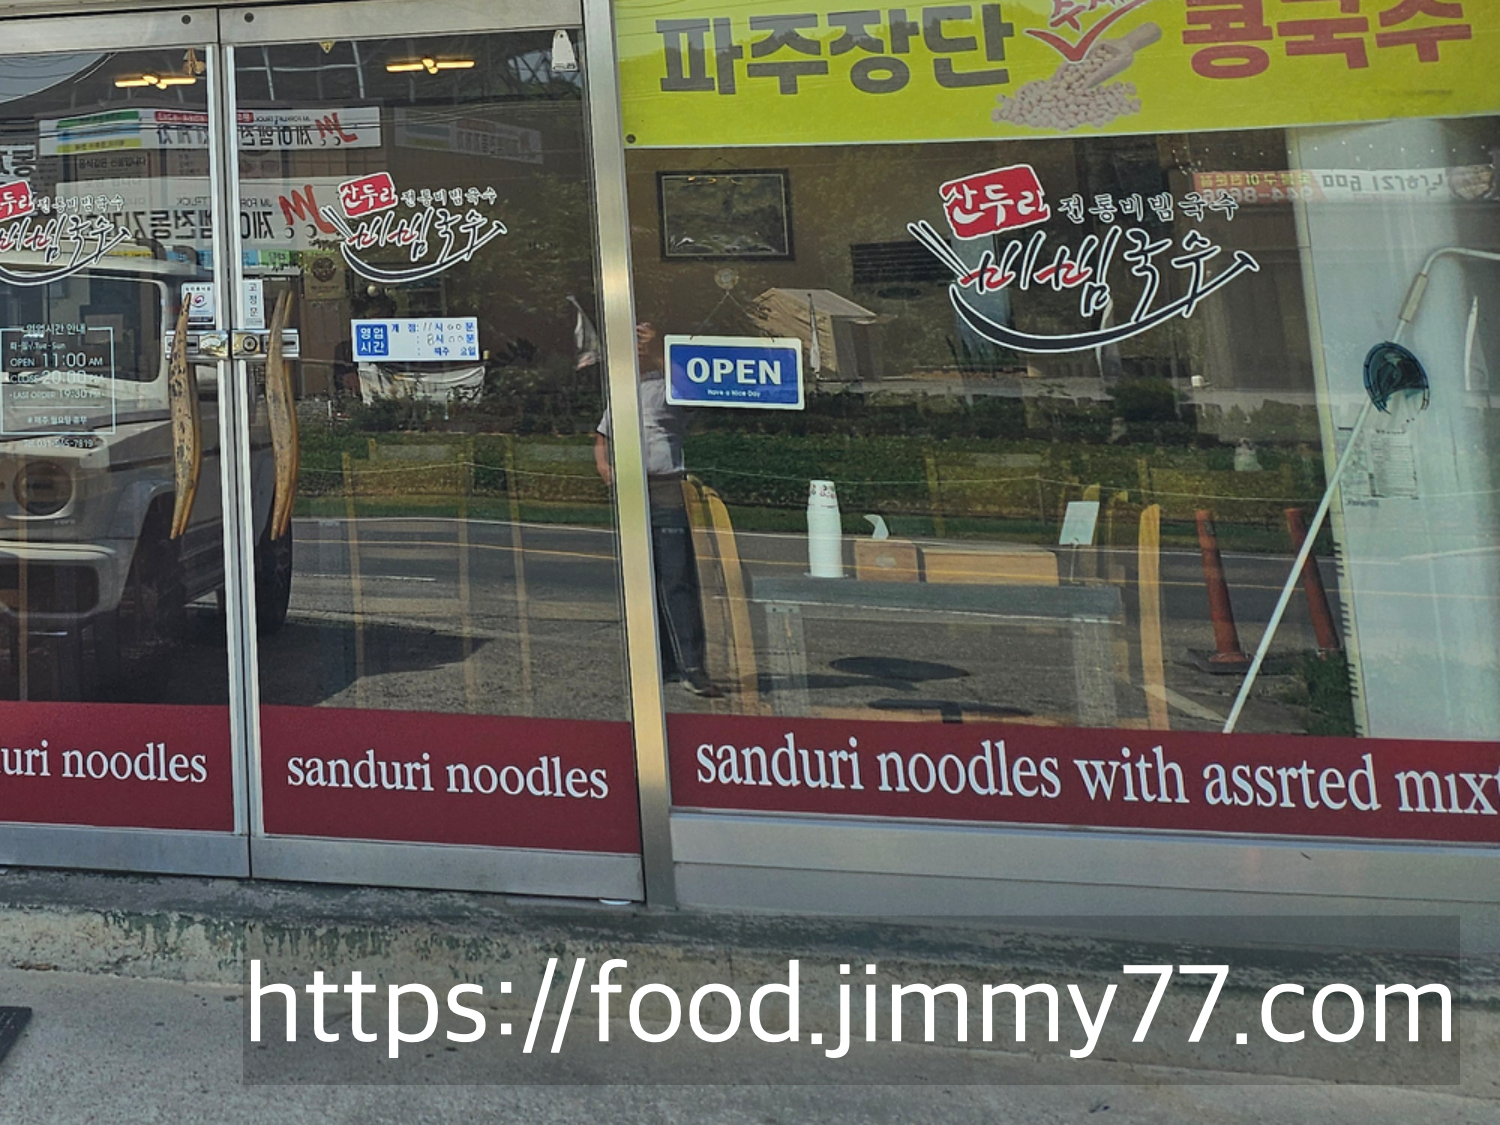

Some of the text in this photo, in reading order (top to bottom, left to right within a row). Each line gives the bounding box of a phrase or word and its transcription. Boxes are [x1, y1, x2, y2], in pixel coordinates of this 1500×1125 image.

[655, 1, 1015, 96] 파주장단
[340, 182, 397, 210] 산두리
[942, 182, 1239, 225] 산두리 전통비빔국수
[360, 327, 384, 340] 영업
[361, 341, 385, 353] 시간
[10, 352, 104, 368] OPEN 11:00 AM
[686, 356, 782, 386] OPEN
[707, 388, 724, 397] Have
[731, 389, 747, 398] Nice
[747, 390, 761, 399] Day
[62, 741, 208, 784] noodles
[287, 748, 609, 799] sanduri noodles
[696, 731, 1500, 816] sanduri noodles with assrted mix
